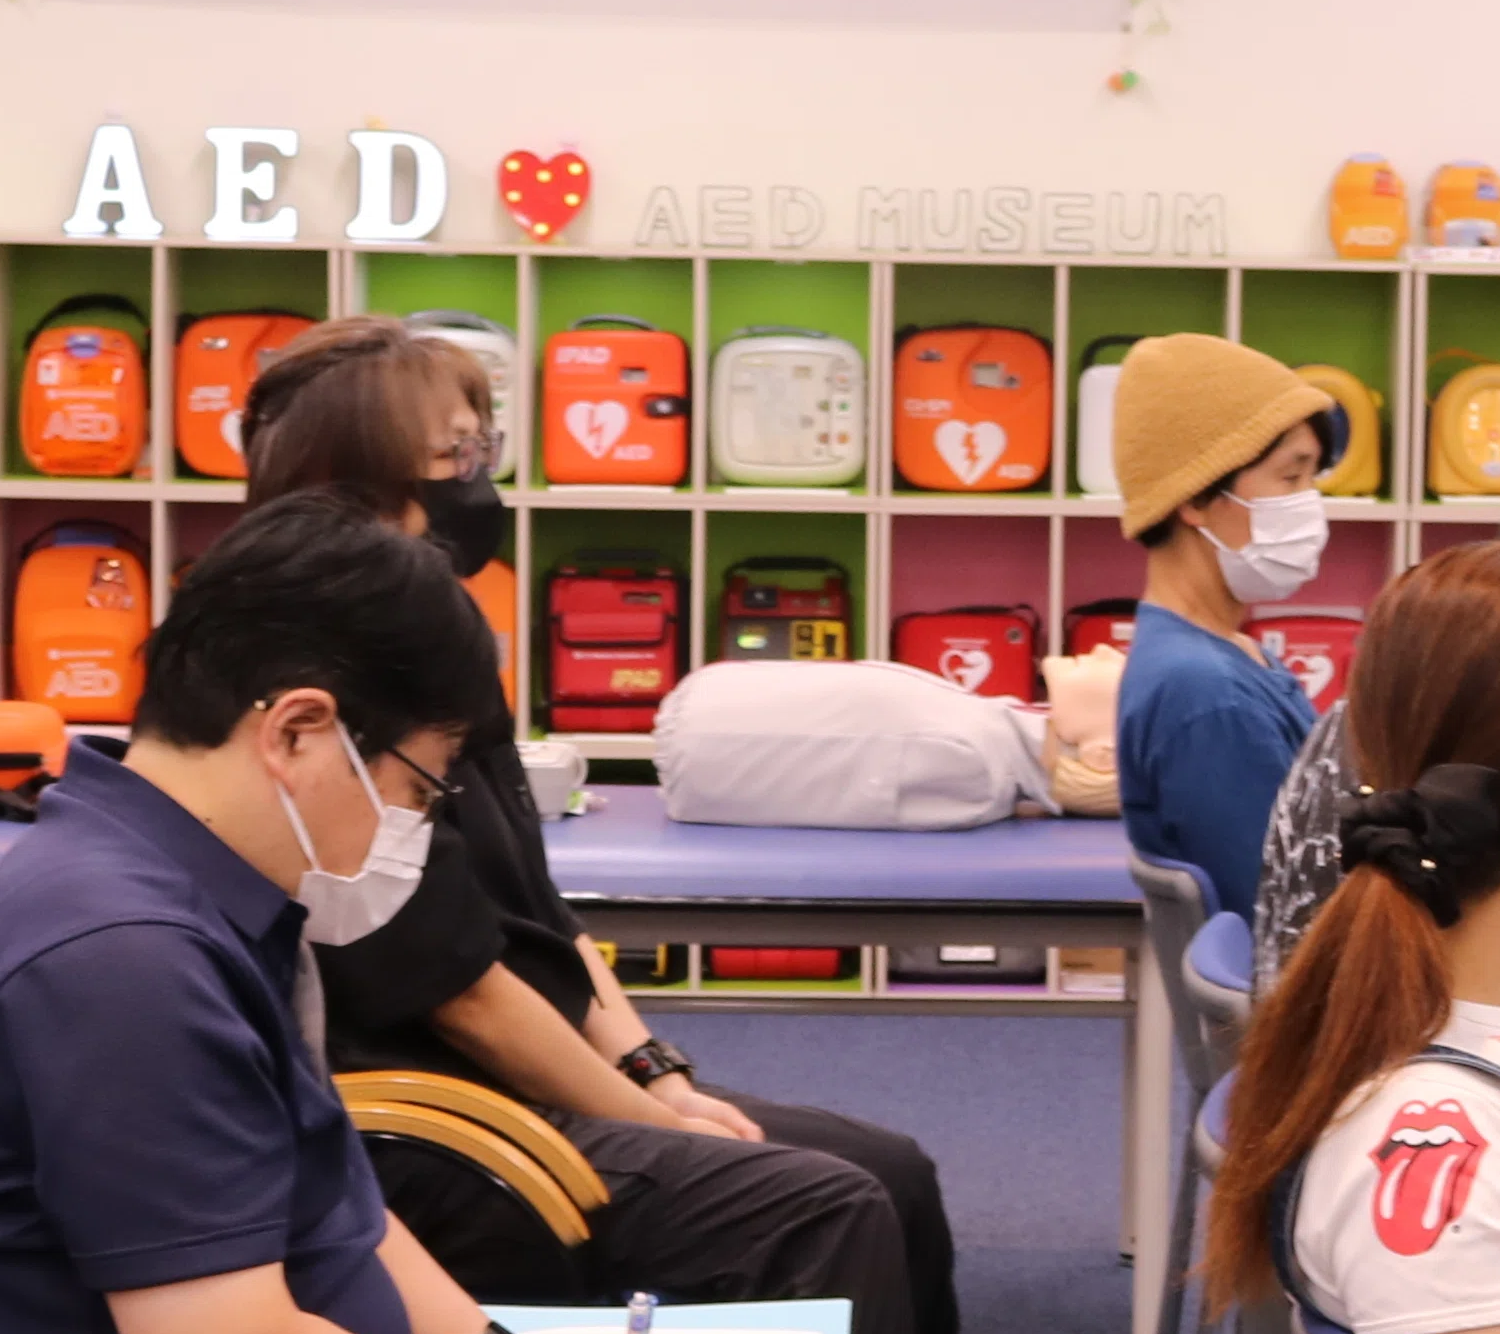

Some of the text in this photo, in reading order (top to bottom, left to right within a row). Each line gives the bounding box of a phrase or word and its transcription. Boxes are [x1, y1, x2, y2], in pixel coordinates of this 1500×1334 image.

[62, 123, 448, 242] AED
[634, 184, 1229, 257] AED MUSEUM
[42, 410, 121, 442] AED
[45, 670, 121, 699] AED
